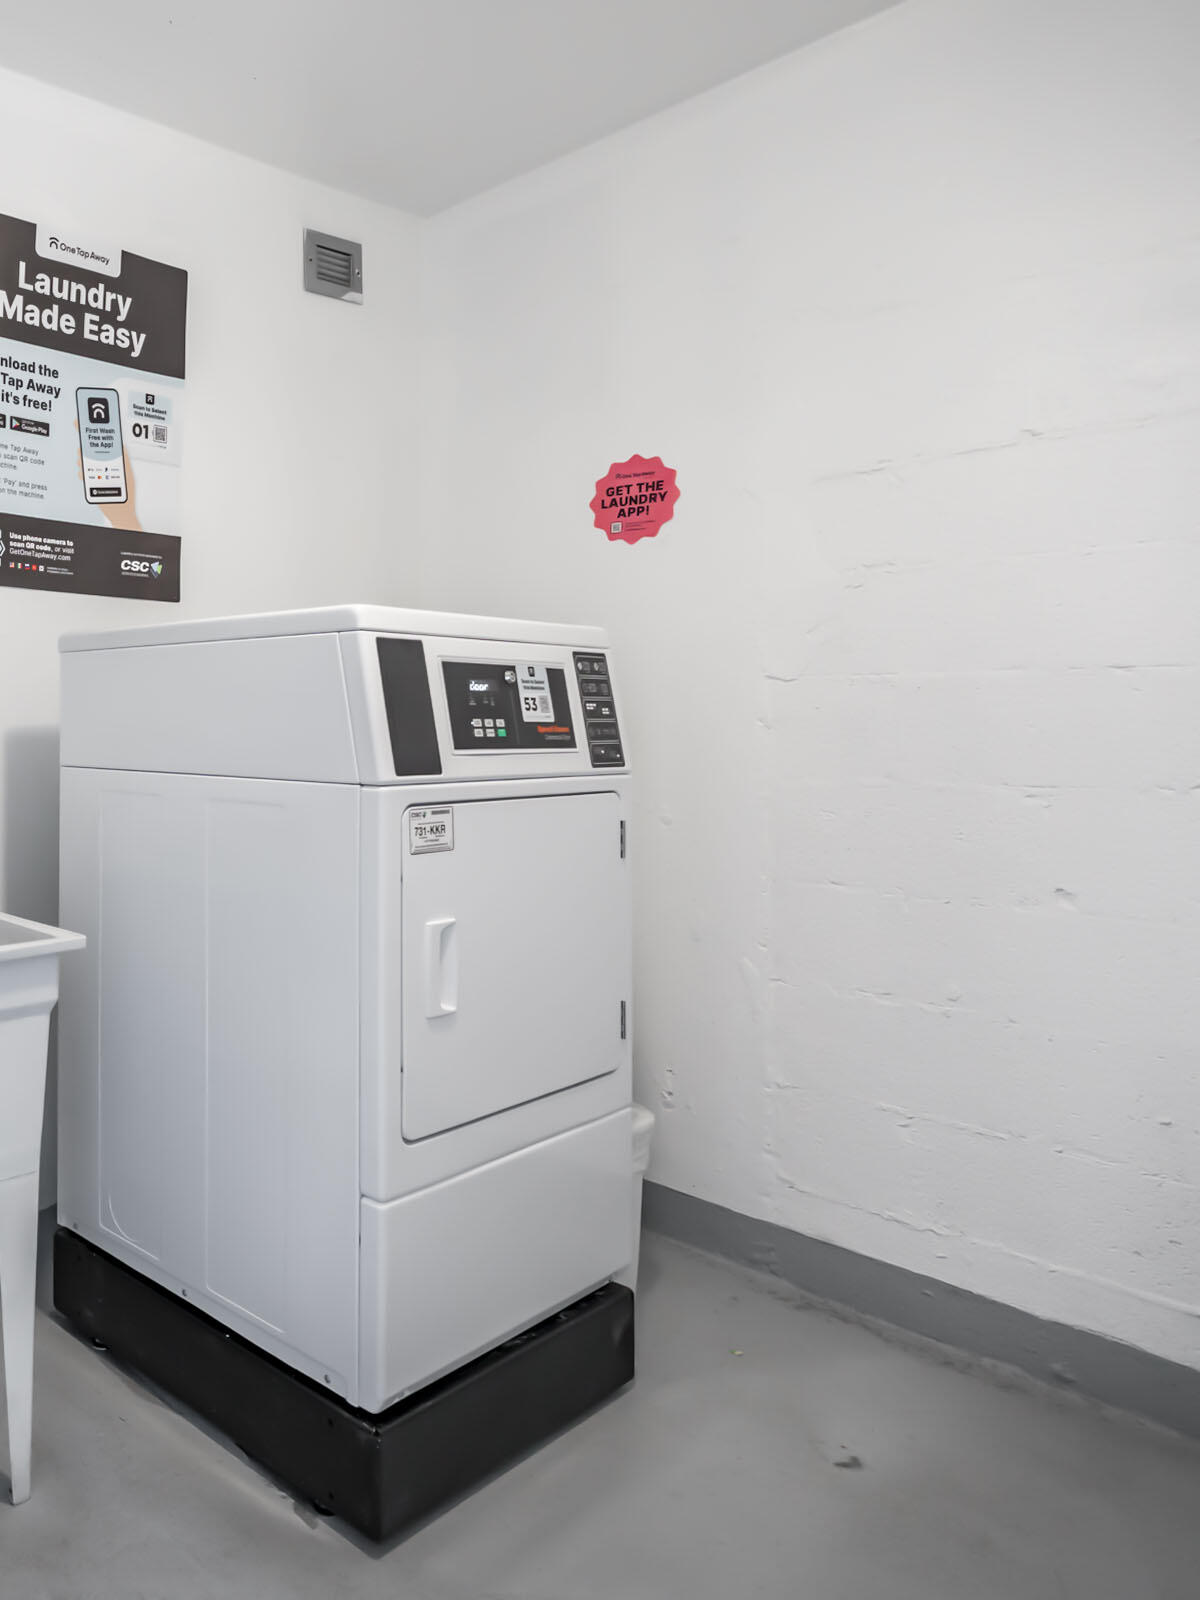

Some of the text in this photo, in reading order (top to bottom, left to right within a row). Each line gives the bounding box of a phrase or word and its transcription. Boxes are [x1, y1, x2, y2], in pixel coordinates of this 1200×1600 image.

[18, 260, 132, 322] Laundry
[83, 312, 146, 358] Easy
[38, 364, 59, 378] the
[0, 372, 24, 390] Tap
[26, 378, 61, 399] Away
[1, 389, 20, 405] it's
[23, 394, 52, 412] free!
[132, 422, 149, 439] 01
[10, 444, 21, 453] Tap
[22, 447, 39, 456] Away
[19, 455, 29, 463] QR
[18, 480, 30, 488] and
[31, 483, 48, 491] press
[606, 480, 664, 497] GET THE
[601, 491, 668, 509] LAUNDRY
[617, 505, 650, 518] APP!
[9, 531, 22, 539] Use
[22, 534, 42, 542] phone
[43, 538, 66, 546] camera
[9, 547, 72, 561] GetOneTapAway.com
[121, 559, 150, 572] CSC
[523, 697, 538, 711] 53
